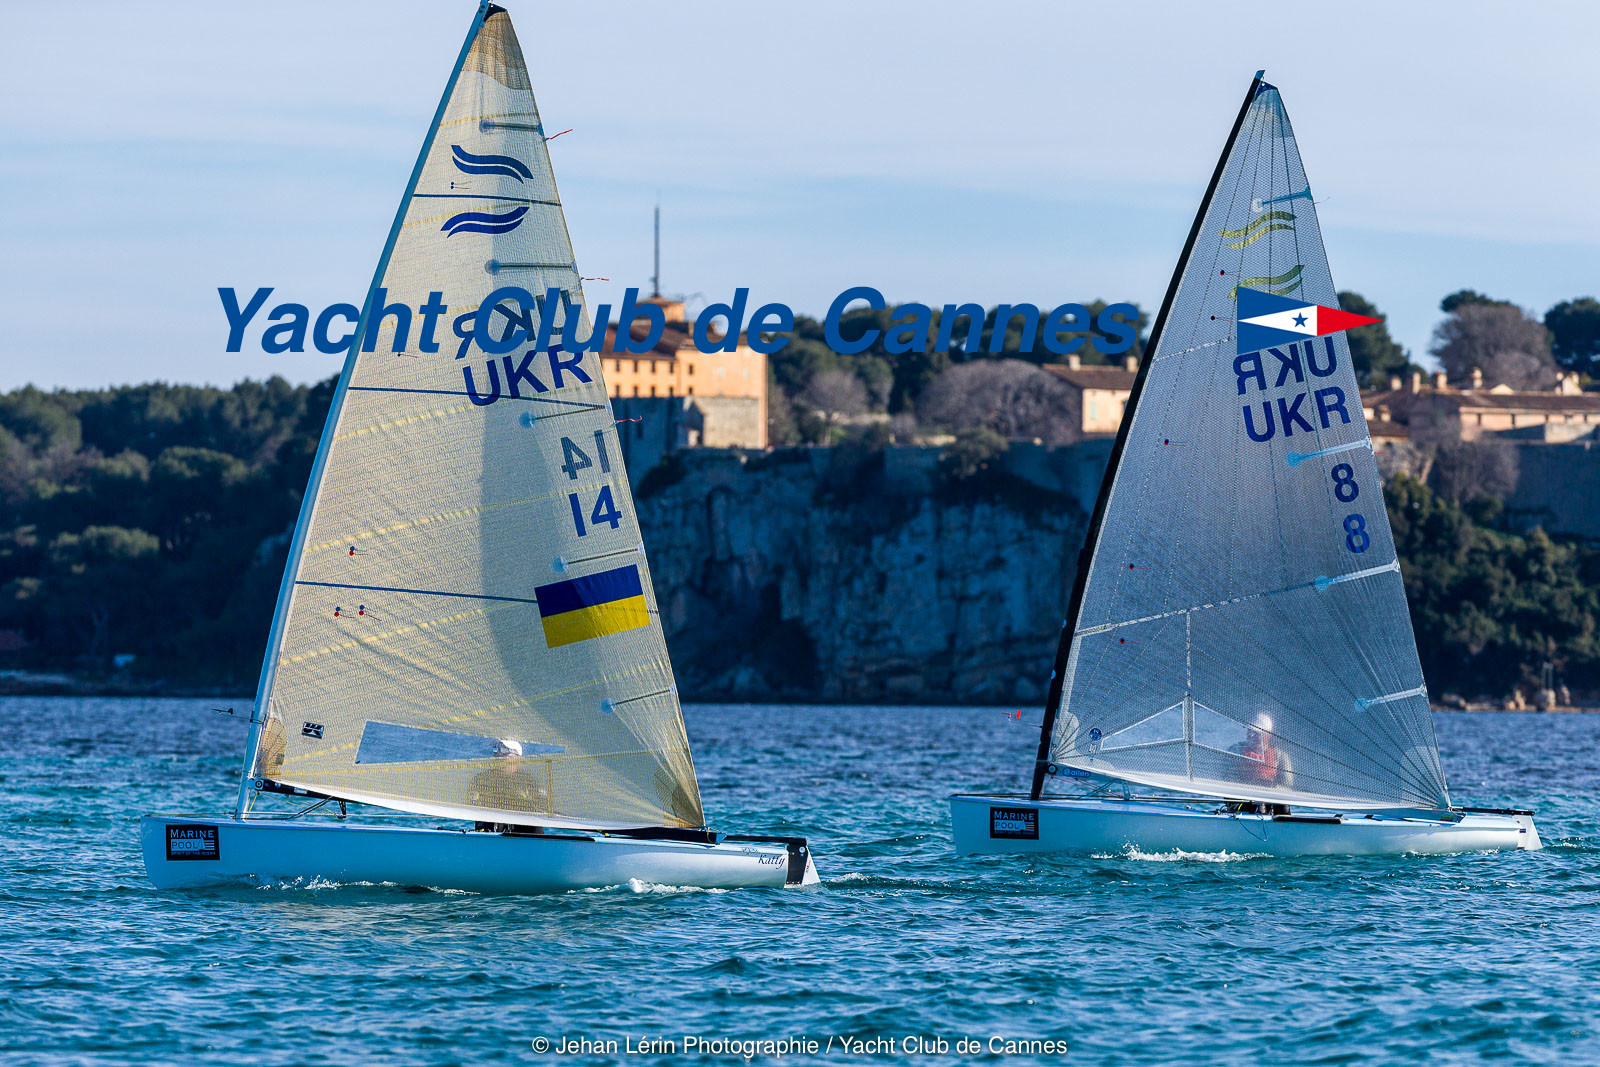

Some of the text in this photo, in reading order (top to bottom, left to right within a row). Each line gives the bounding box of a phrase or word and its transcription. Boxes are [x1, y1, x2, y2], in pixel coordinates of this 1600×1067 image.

[463, 343, 593, 406] UKR
[1243, 386, 1351, 442] UKR
[569, 485, 622, 537] 14
[1343, 513, 1370, 554] 8
[994, 811, 1035, 820] MARINE
[995, 821, 1019, 829] POOL
[170, 829, 214, 838] MARINE
[172, 841, 198, 849] POOL
